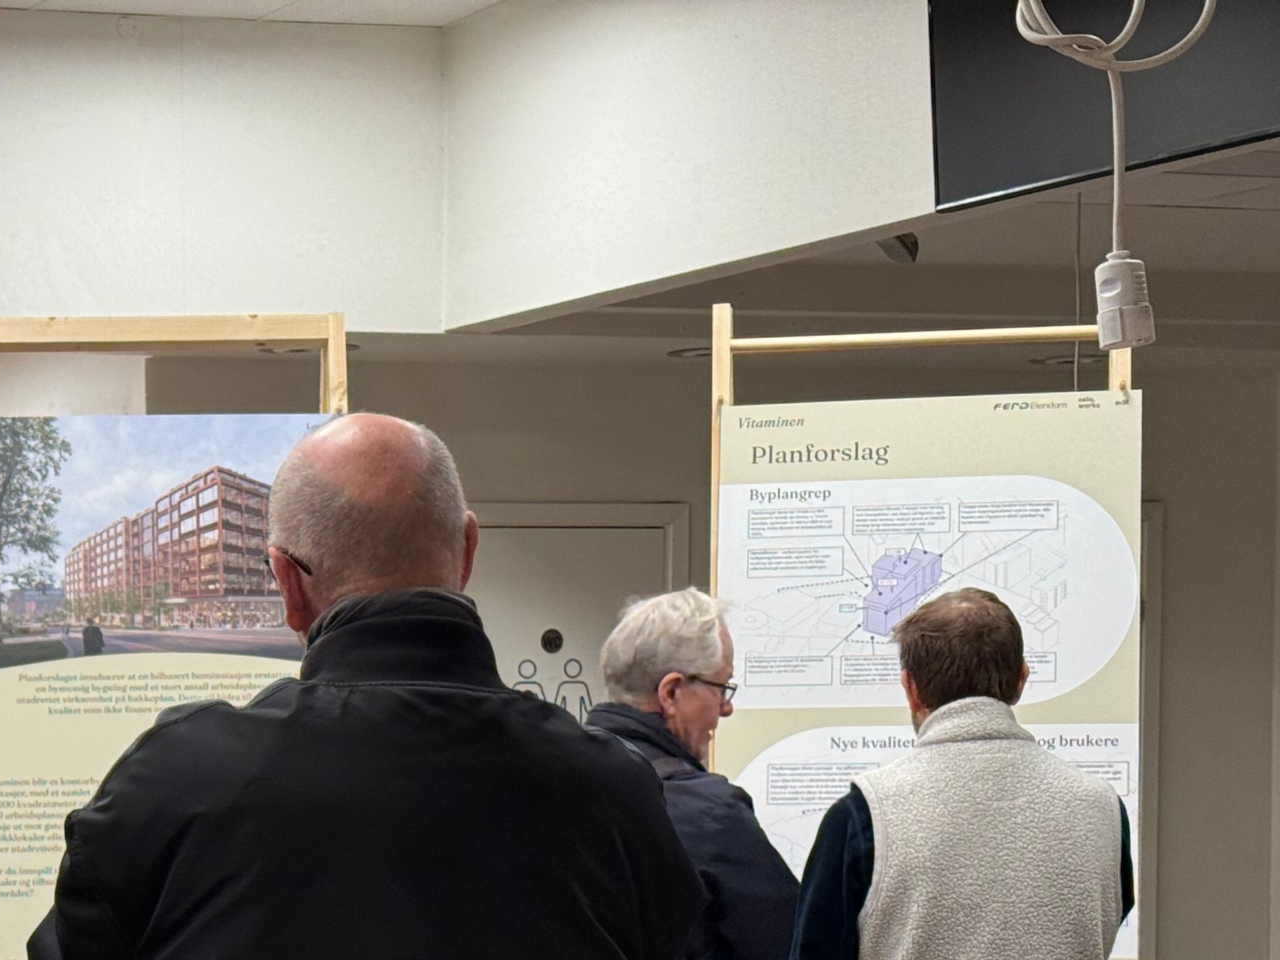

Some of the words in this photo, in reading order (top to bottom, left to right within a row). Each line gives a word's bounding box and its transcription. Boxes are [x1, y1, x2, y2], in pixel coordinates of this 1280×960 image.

[1030, 402, 1067, 410] Eiendom
[738, 416, 805, 429] Vitaminen
[751, 442, 890, 466] Planforslag
[749, 488, 831, 504] Byplangrep
[36, 685, 47, 693] en
[184, 683, 209, 691] antall
[48, 707, 81, 715] kvalitet
[830, 737, 858, 752] Nye
[862, 737, 916, 749] kvalitet
[1037, 737, 1056, 750] og
[1059, 734, 1120, 747] brukere
[60, 777, 100, 787] kontorby
[29, 789, 49, 797] med
[5, 811, 64, 820] arbeidsplasse
